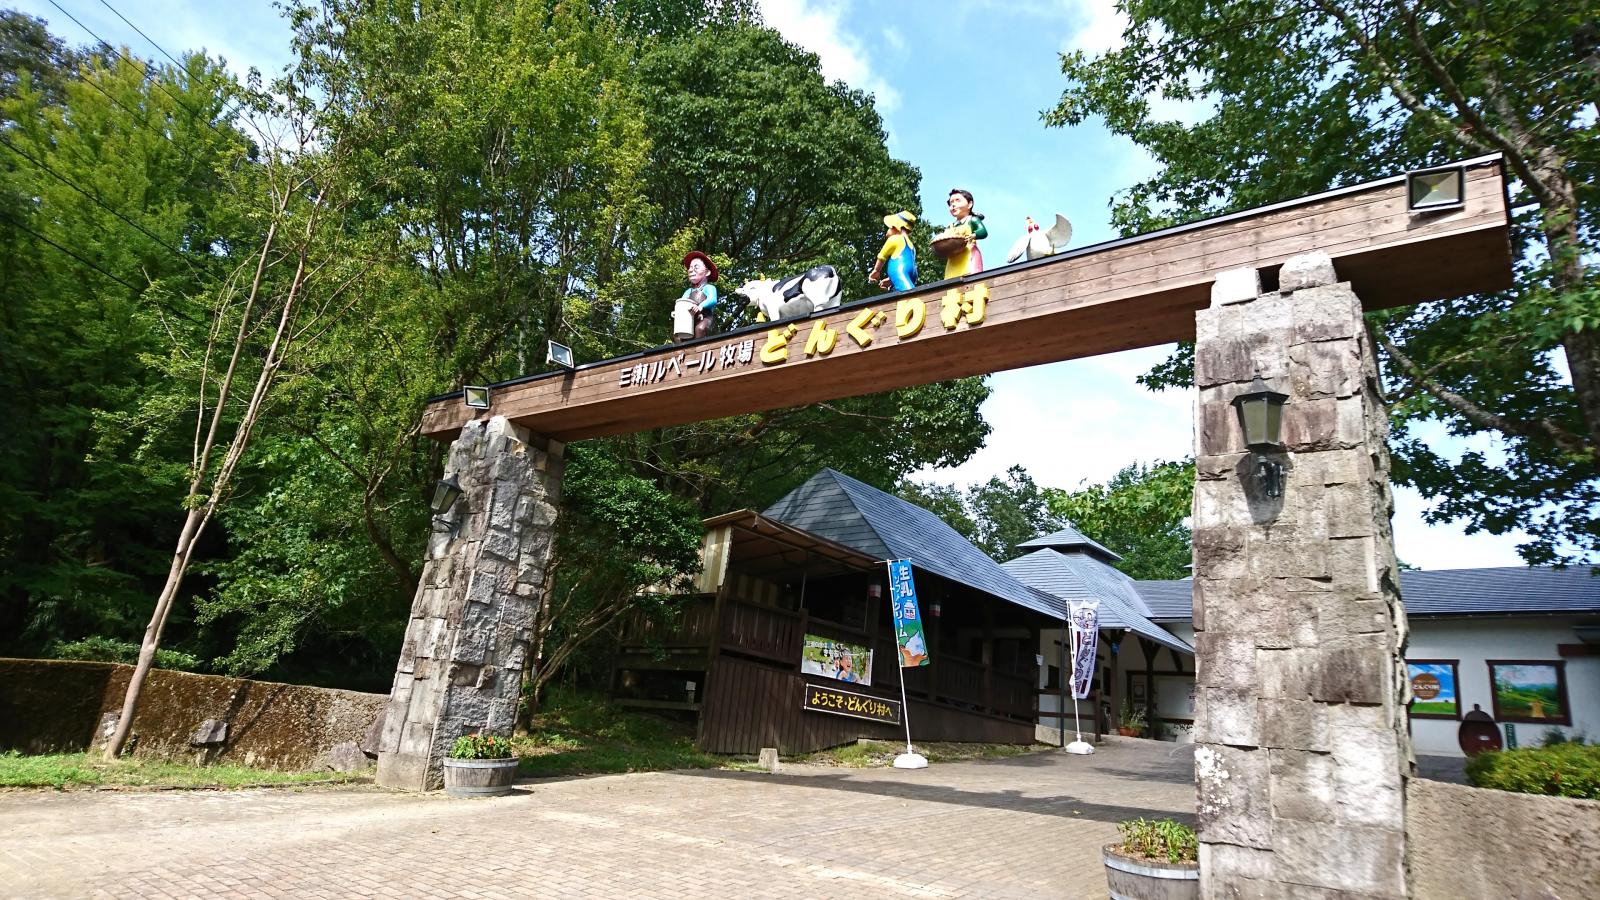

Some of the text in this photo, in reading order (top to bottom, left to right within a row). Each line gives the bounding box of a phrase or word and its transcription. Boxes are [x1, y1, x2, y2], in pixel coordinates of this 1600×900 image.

[759, 282, 990, 365] どんぐり村
[899, 565, 914, 597] 生乳
